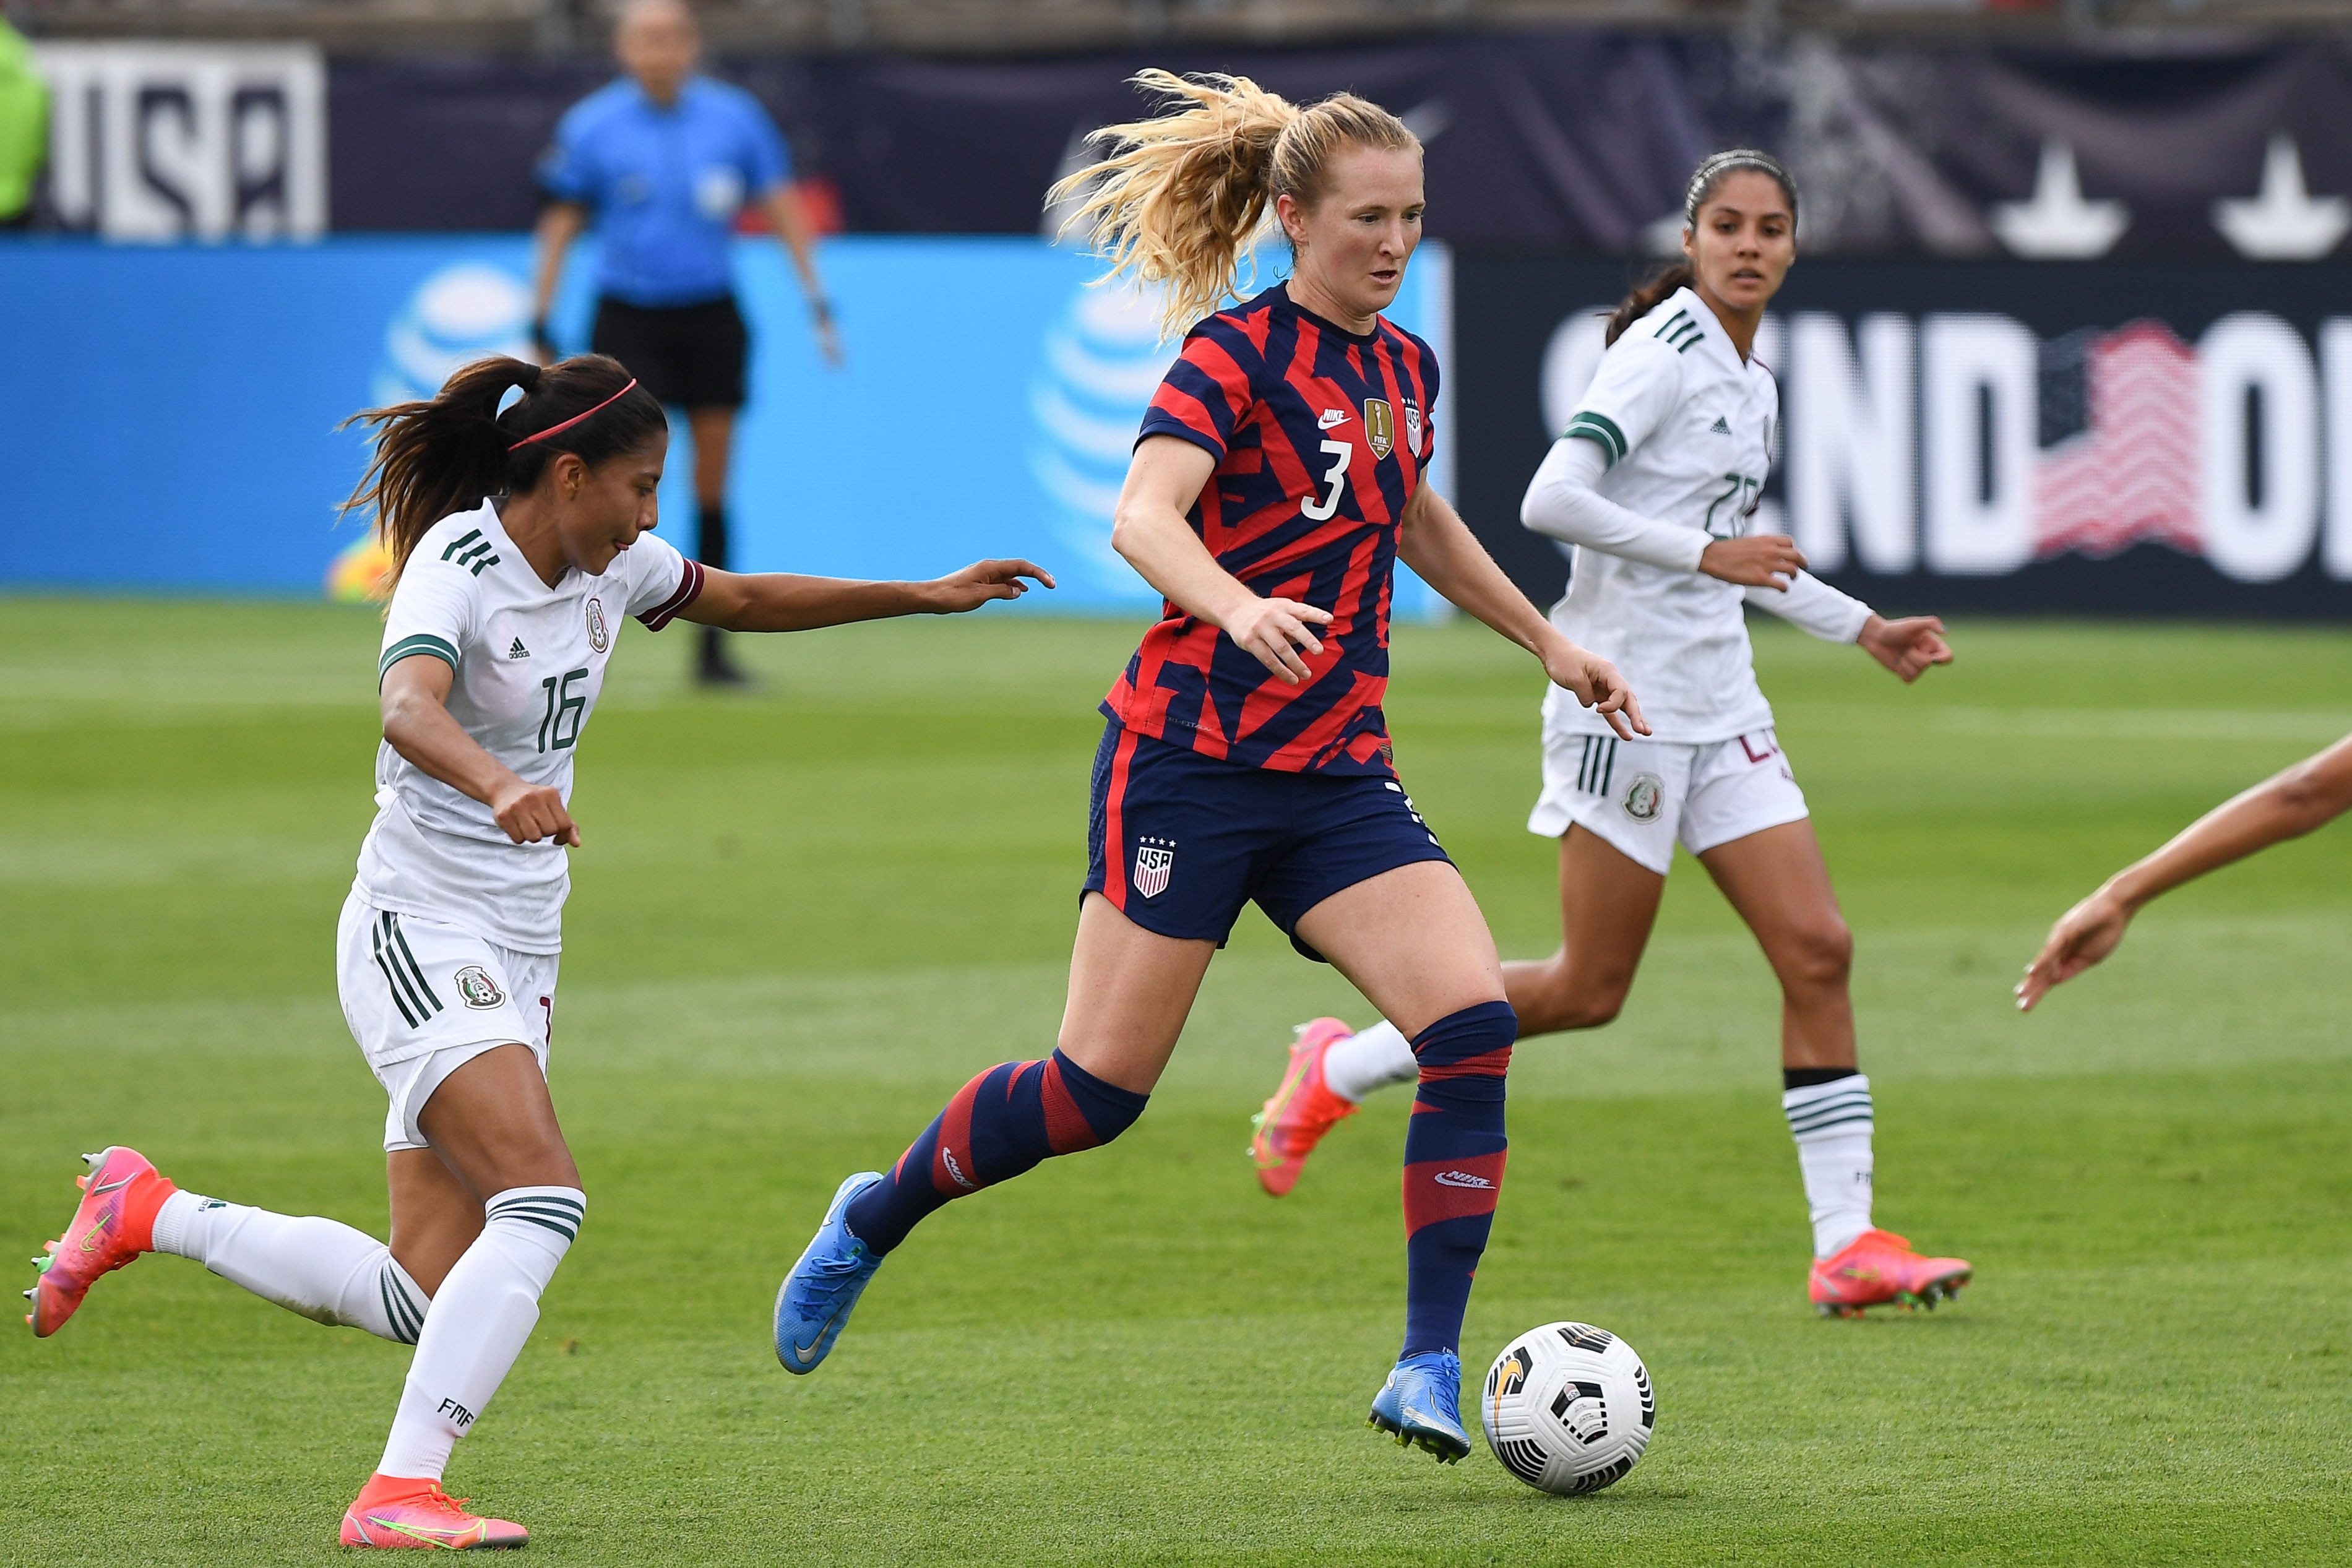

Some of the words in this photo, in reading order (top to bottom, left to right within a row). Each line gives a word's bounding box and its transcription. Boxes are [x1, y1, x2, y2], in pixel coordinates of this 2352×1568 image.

[1323, 408, 1345, 421] NIKE
[1374, 435, 1387, 445] FIFA
[2192, 308, 2352, 585] O
[1300, 439, 1353, 521] 3
[509, 650, 531, 660] adidas
[538, 667, 589, 754] 16
[1139, 849, 1171, 870] USA
[1446, 1170, 1491, 1186] NIKE
[436, 1397, 475, 1428] FMF
